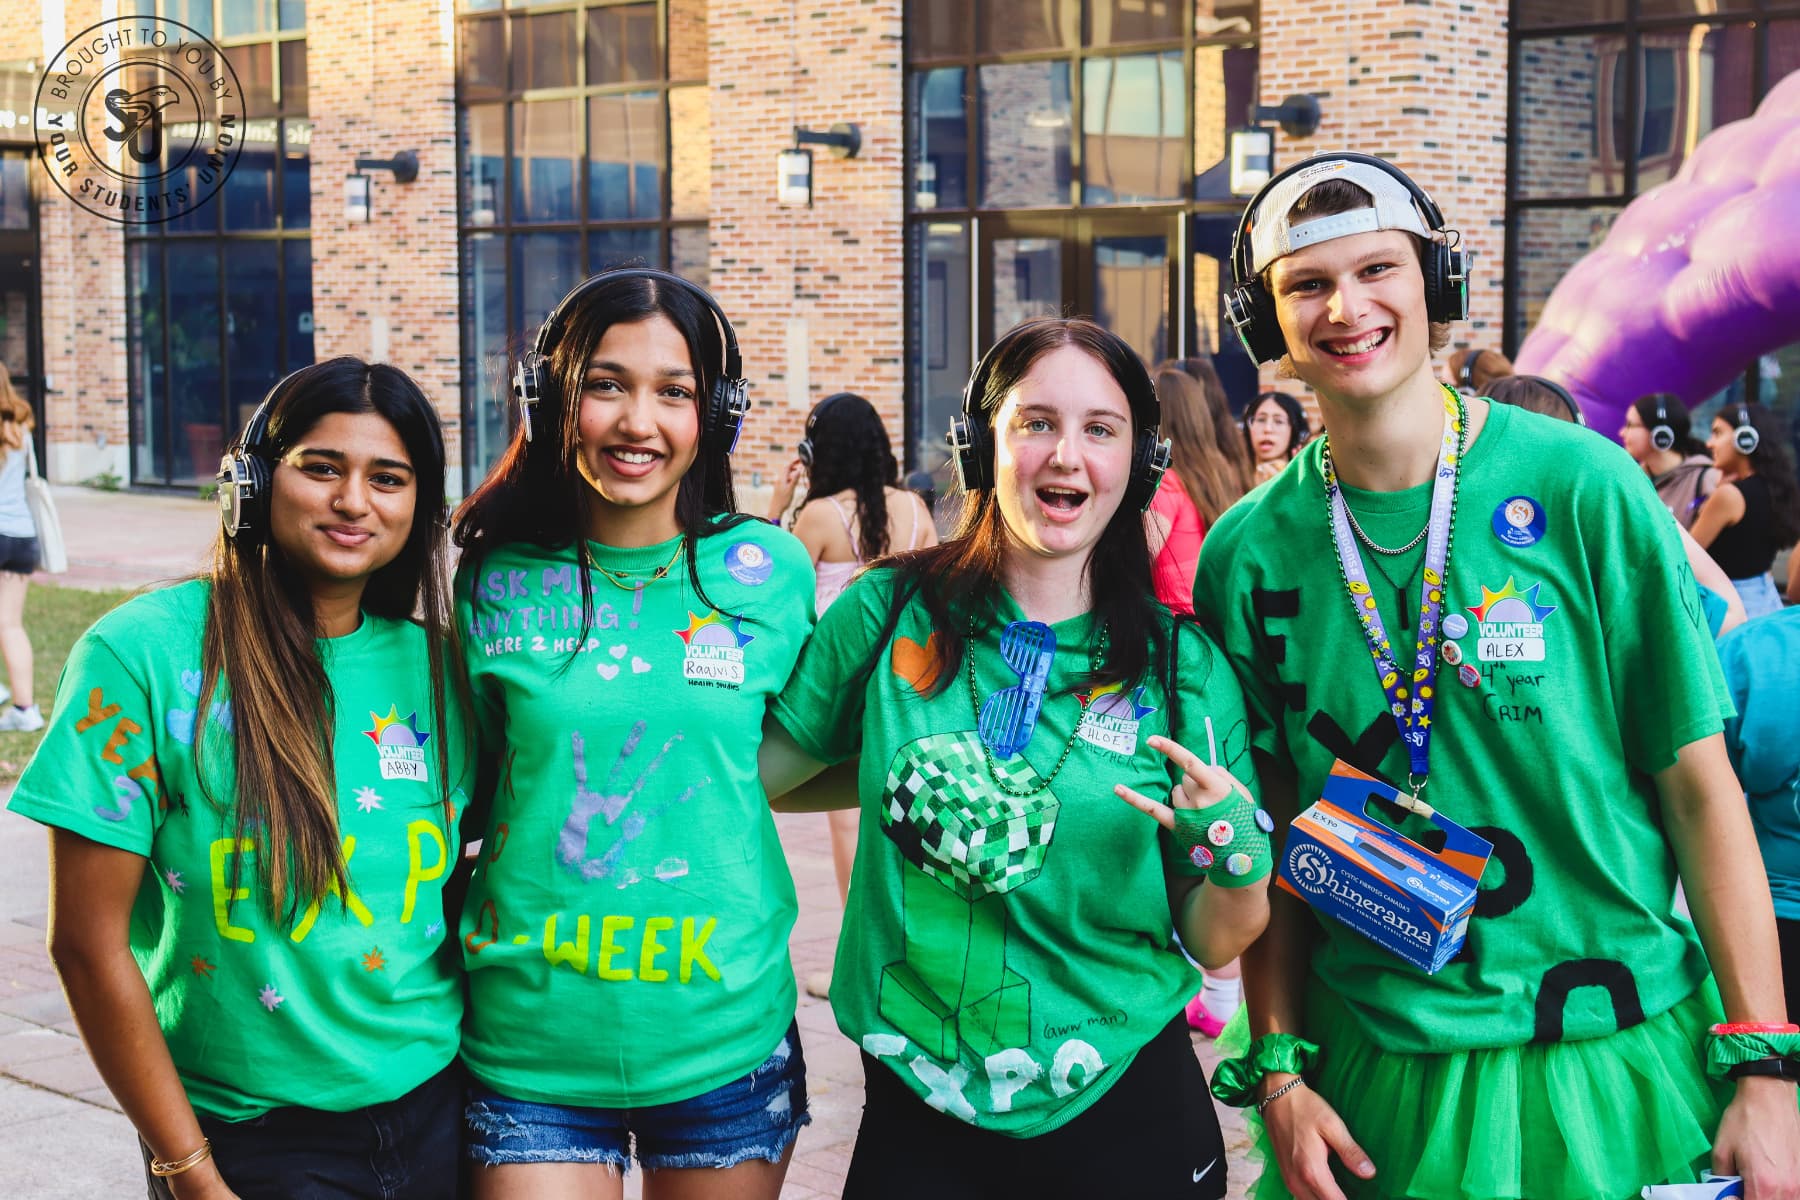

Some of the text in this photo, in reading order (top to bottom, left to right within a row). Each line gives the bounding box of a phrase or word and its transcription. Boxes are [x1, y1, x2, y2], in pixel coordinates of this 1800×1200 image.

[1478, 623, 1544, 638] VOLUNTEER
[485, 636, 599, 657] HERE 2 HELP
[685, 645, 744, 663] VOLUNTEER
[1486, 642, 1524, 658] ALEX
[1482, 661, 1506, 688] 4th
[1506, 674, 1545, 696] year
[1483, 693, 1543, 724] CRIM
[1079, 726, 1120, 745] CHLOE
[378, 745, 424, 762] VOLUNTEER
[387, 761, 417, 777] ABBY
[94, 776, 142, 822] 3
[1341, 869, 1359, 884] CYSTIC
[1296, 852, 1432, 947] Shinerama
[863, 1034, 1107, 1125] XPO
